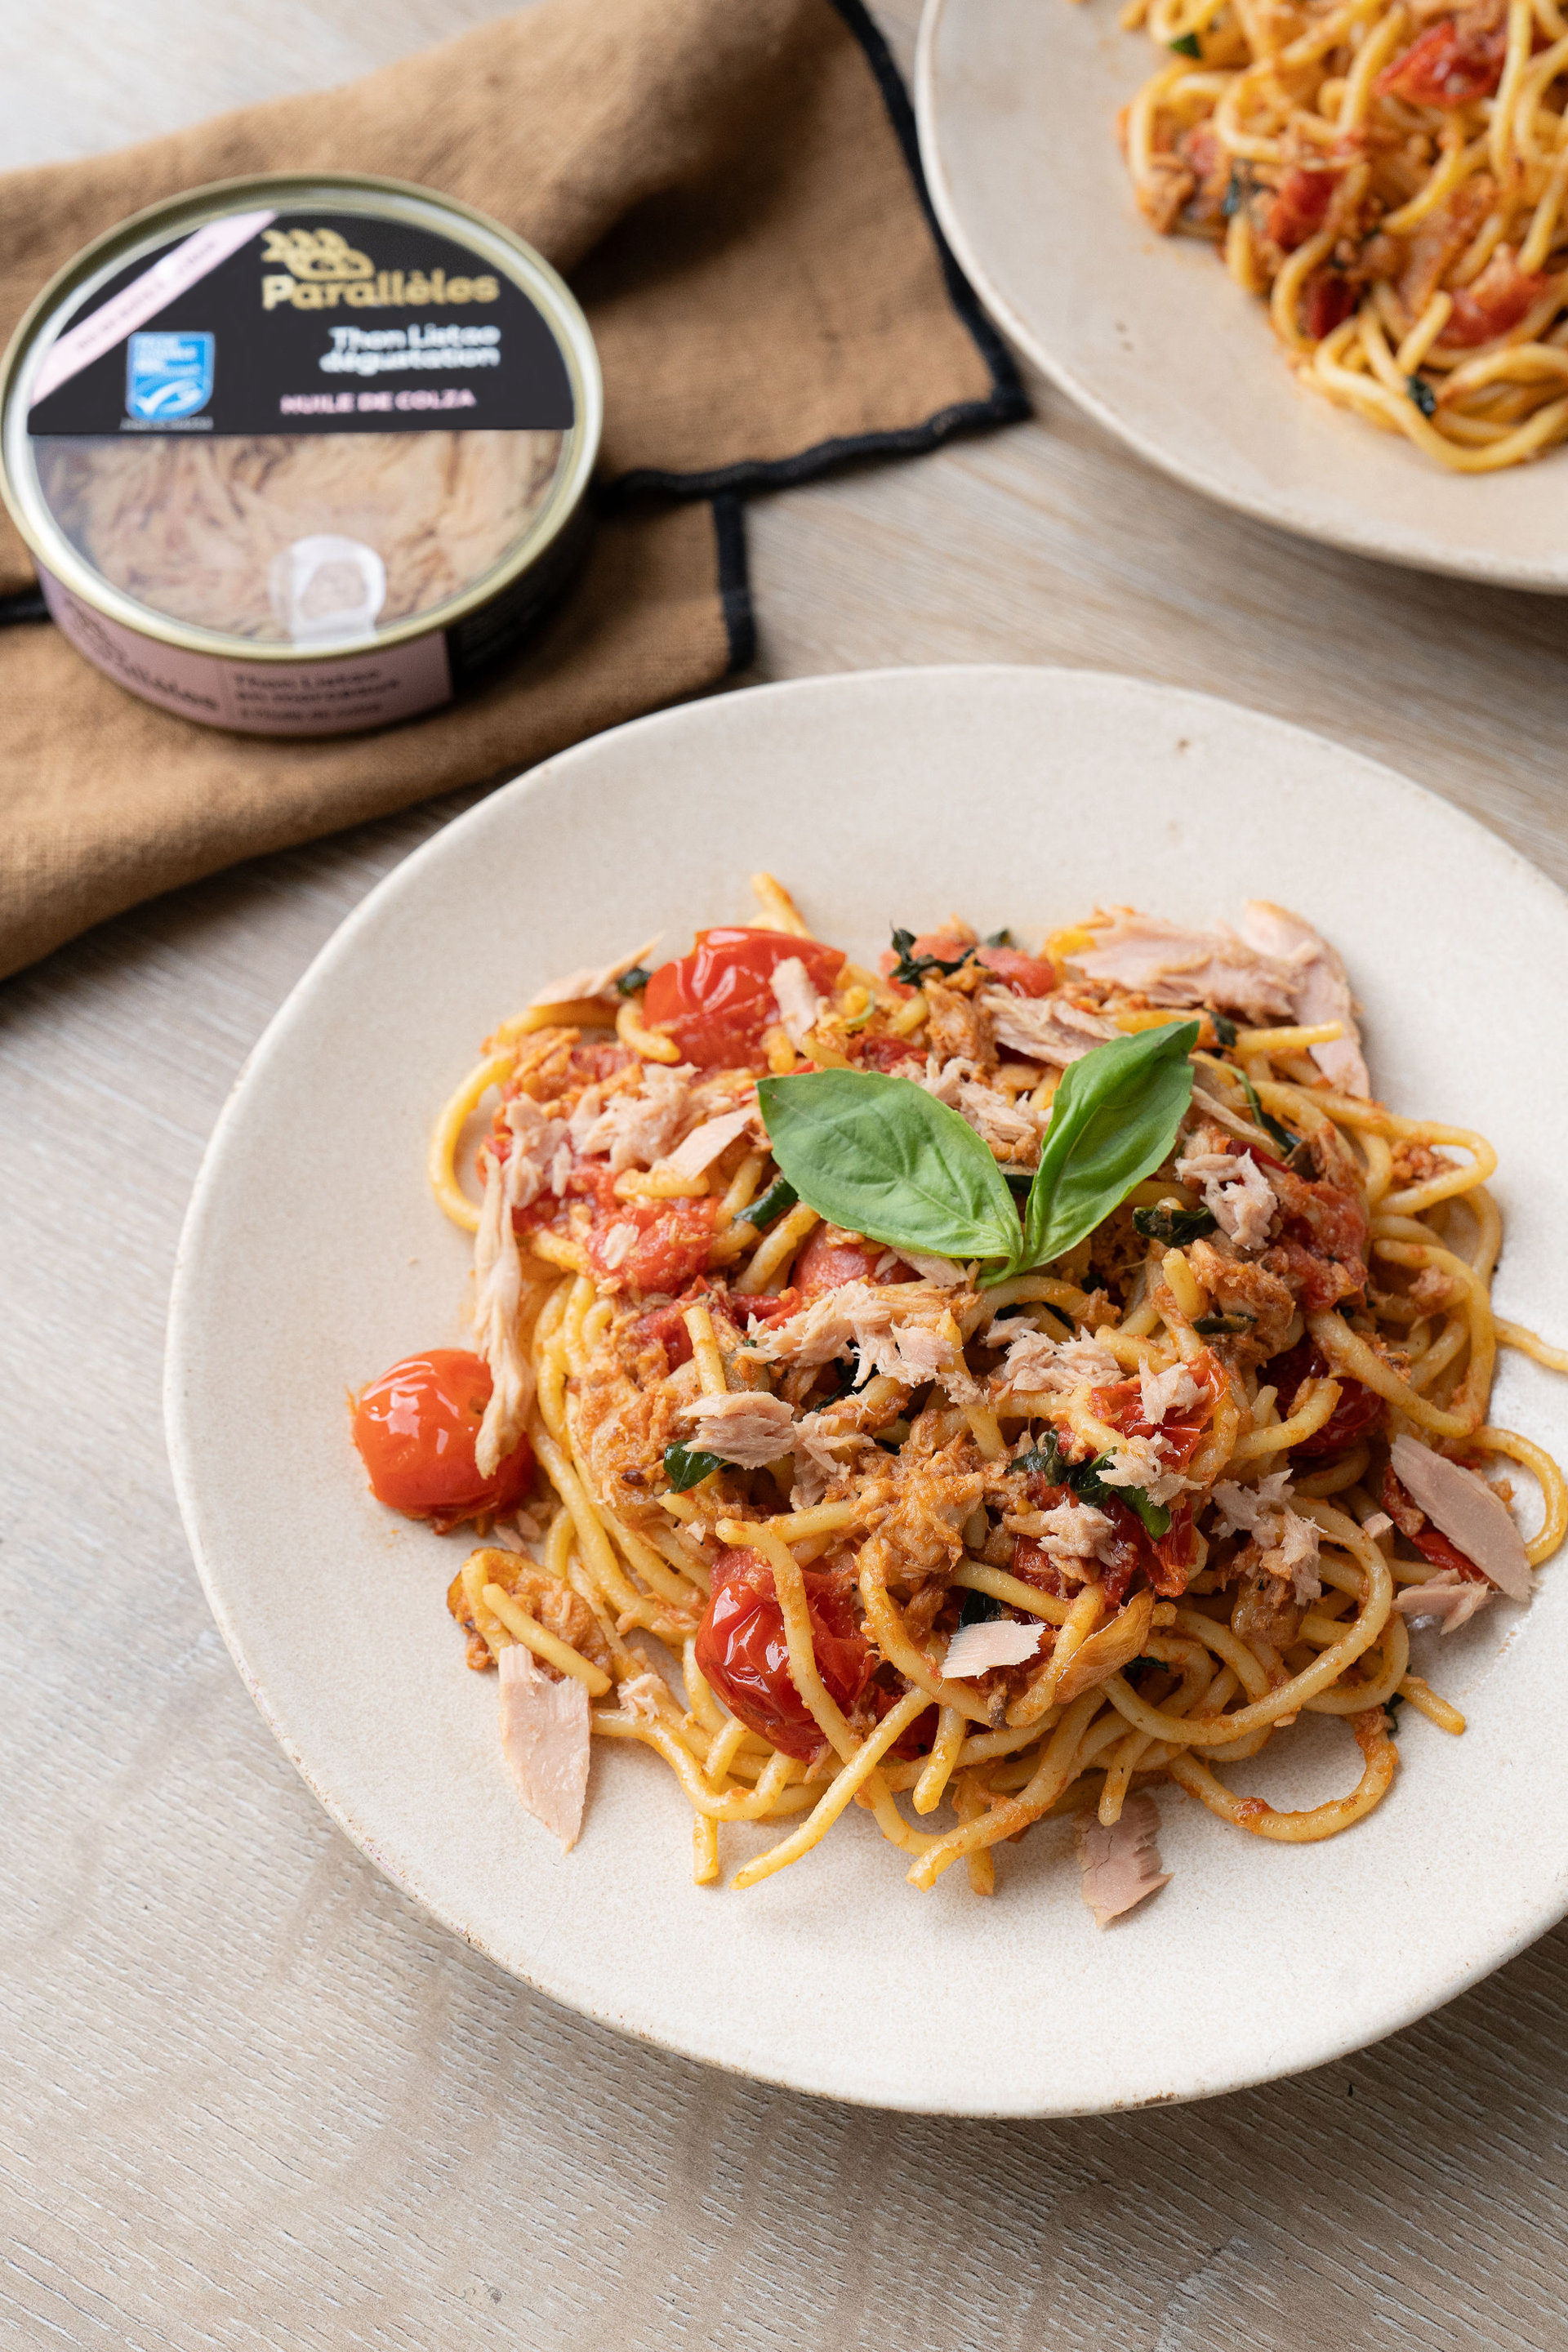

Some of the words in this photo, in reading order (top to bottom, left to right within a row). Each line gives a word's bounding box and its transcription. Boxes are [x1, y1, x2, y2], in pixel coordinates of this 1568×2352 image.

[262, 268, 500, 310] Parallèles
[328, 327, 407, 351] Thon
[280, 392, 355, 414] HUILE
[356, 391, 394, 412] DE
[394, 388, 476, 411] COLZA
